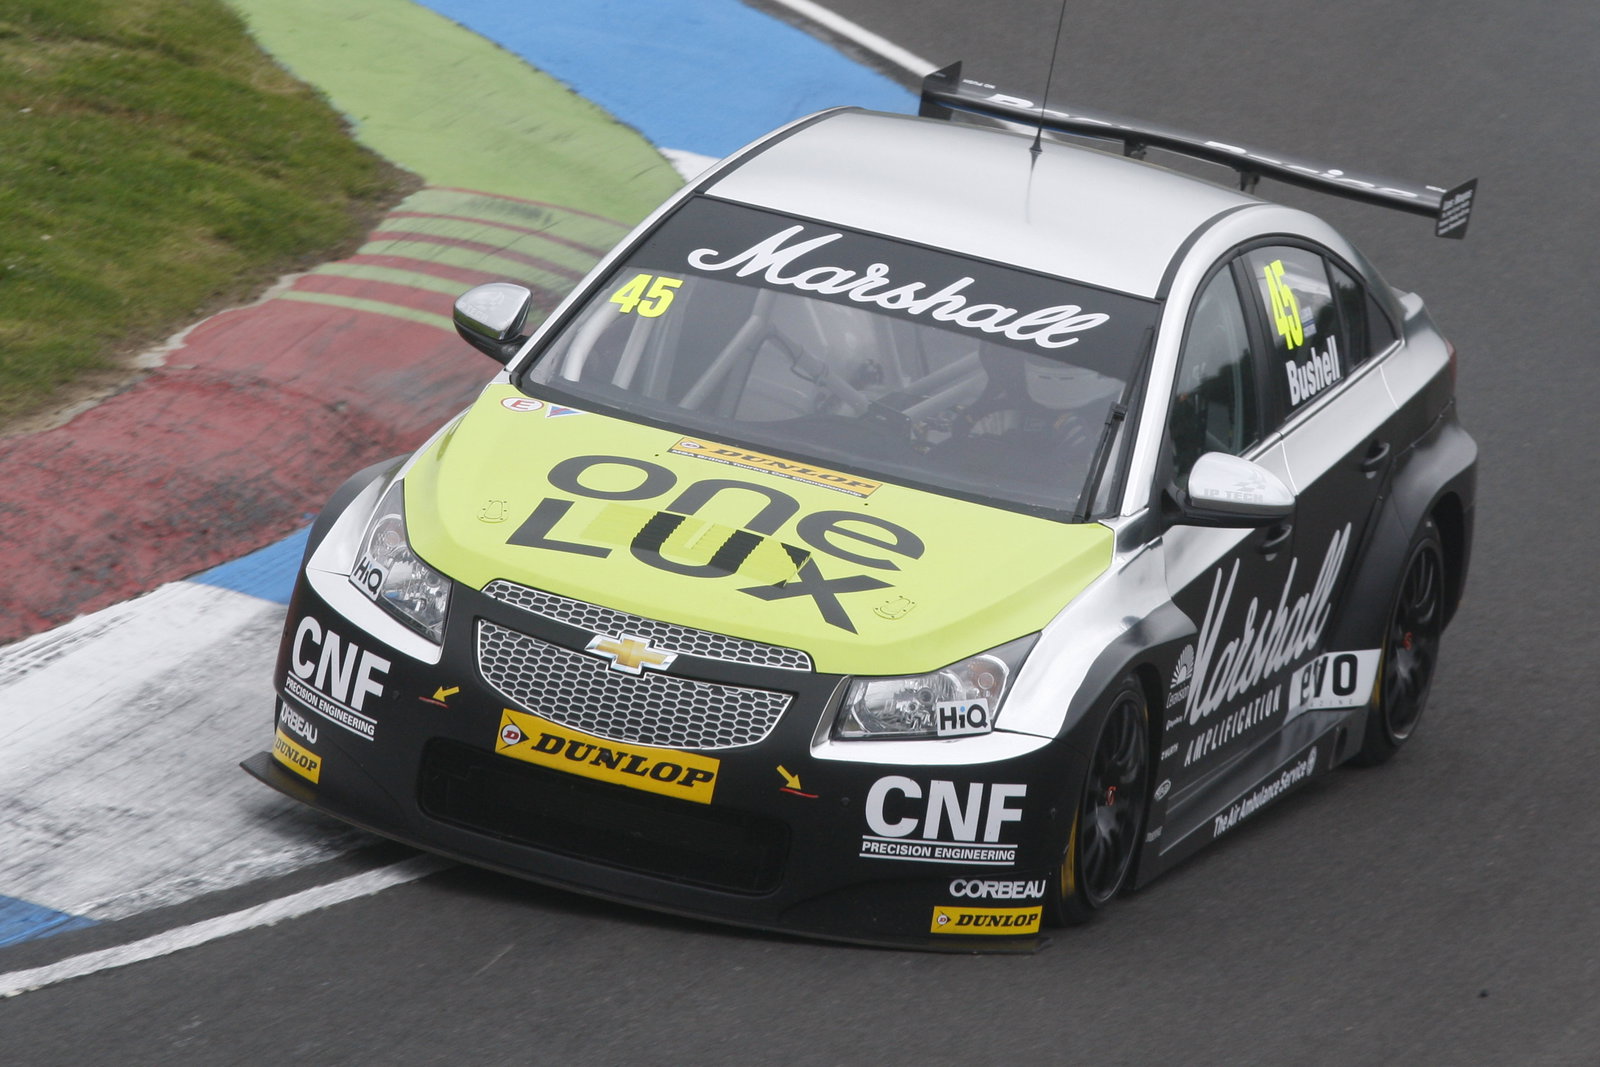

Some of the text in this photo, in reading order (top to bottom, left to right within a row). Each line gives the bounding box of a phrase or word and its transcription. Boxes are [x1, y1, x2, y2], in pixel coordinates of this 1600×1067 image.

[609, 274, 684, 318] 45
[687, 225, 1110, 349] Marshall
[1263, 259, 1303, 350] 45
[1285, 334, 1341, 406] Bushell
[711, 448, 874, 489] DUNLOP
[547, 455, 925, 571] one
[353, 556, 383, 595] HiQ
[505, 497, 895, 636] LUX
[1184, 522, 1352, 726] Marshall
[292, 616, 392, 712] CNF
[280, 701, 318, 745] ORBEAU
[285, 677, 376, 737] PRECISION ENGINEERING
[939, 703, 989, 731] HiQ
[1184, 684, 1283, 767] AMPLIFICATION
[275, 738, 318, 772] DUNLOP
[531, 732, 715, 788] DUNLOP
[865, 775, 1027, 843] CNF
[862, 841, 1016, 861] PRECISION ENGINEERING
[949, 879, 1047, 899] CORBEAU
[955, 914, 1039, 928] DUNLOP
